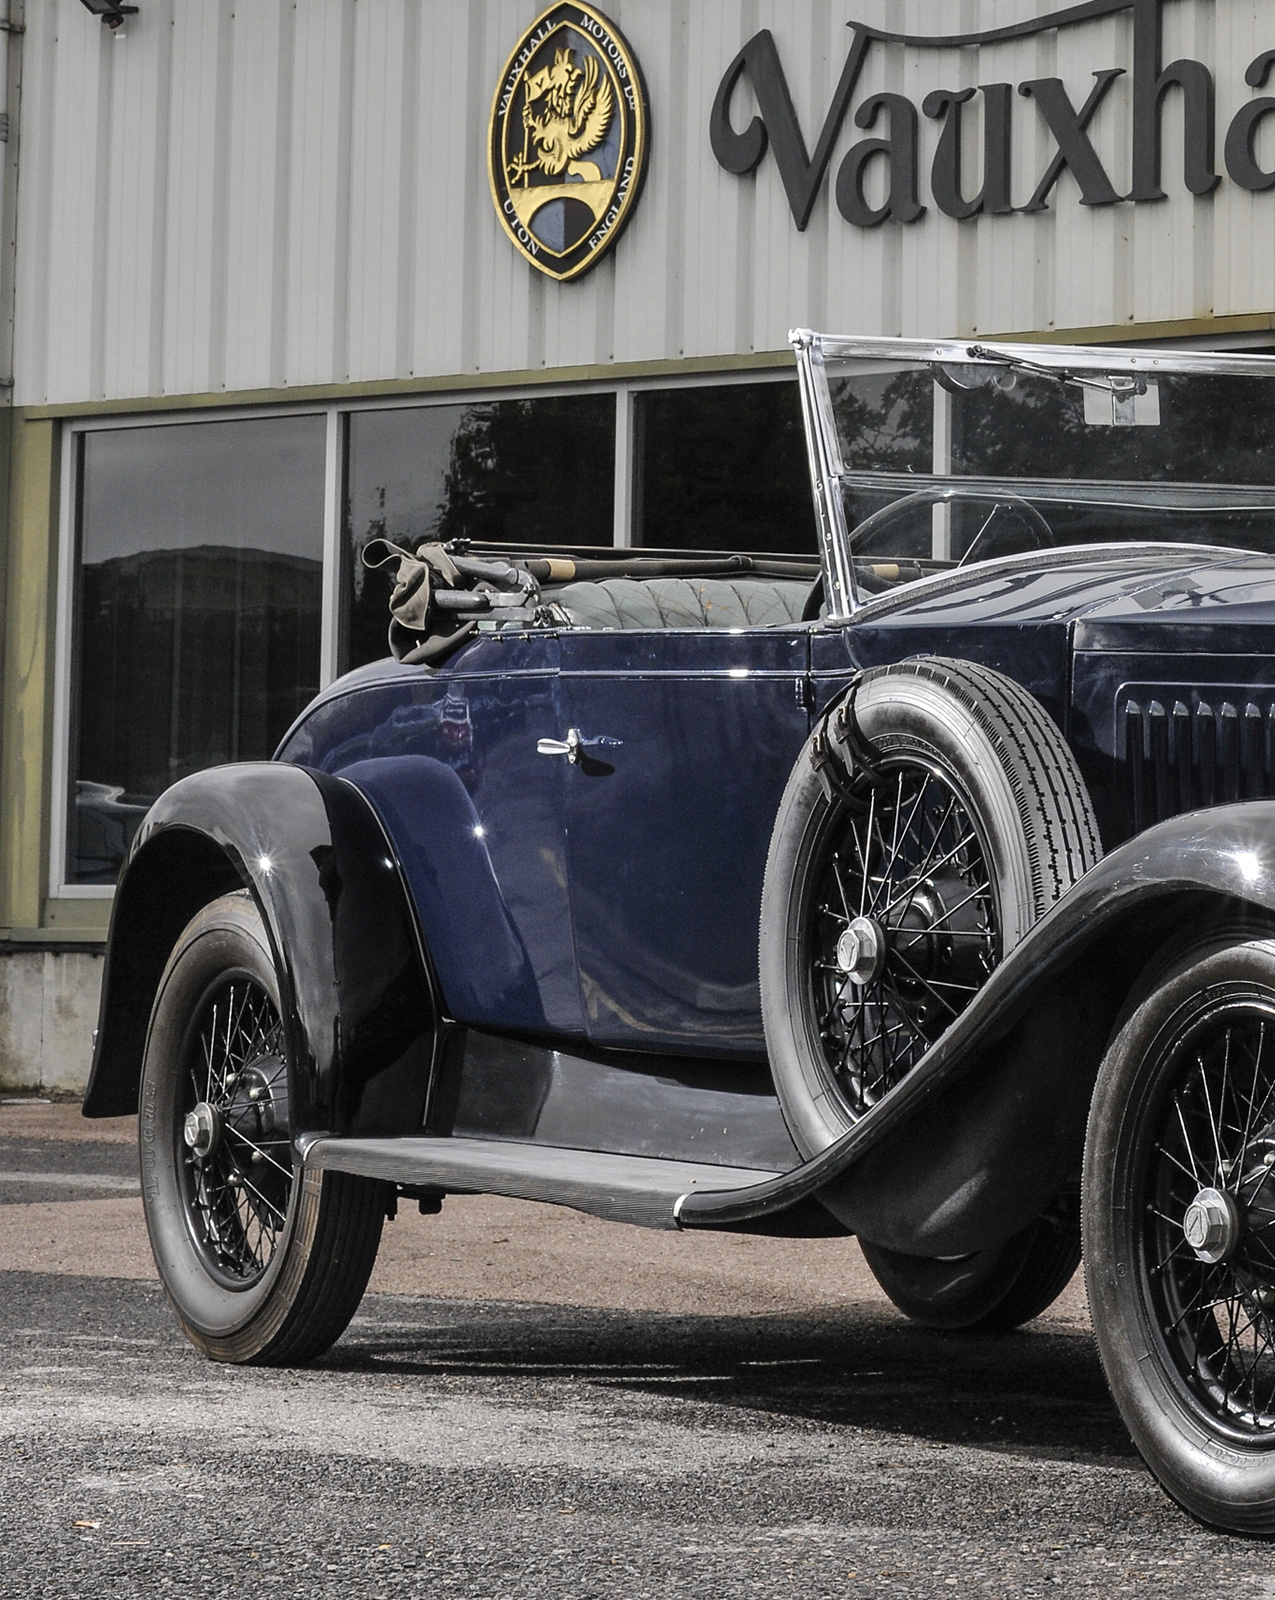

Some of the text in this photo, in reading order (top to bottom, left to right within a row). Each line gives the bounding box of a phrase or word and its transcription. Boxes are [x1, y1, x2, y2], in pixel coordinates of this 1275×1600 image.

[498, 20, 557, 115] VAUXHALL
[580, 14, 628, 78] MOTORS
[503, 156, 634, 256] UTON ENGLAND
